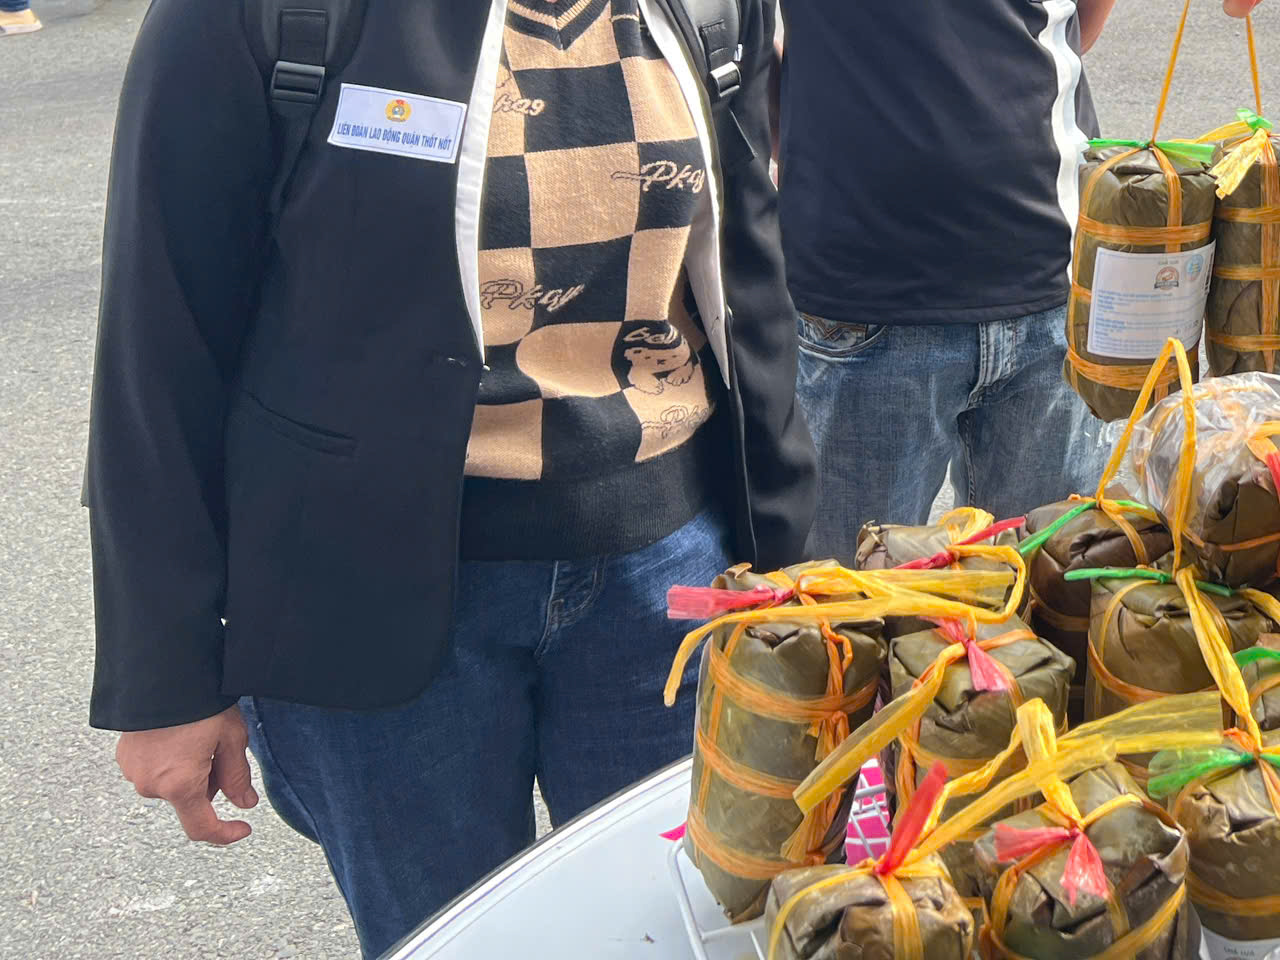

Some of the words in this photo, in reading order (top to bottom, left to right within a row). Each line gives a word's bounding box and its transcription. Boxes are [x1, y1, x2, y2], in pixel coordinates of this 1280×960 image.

[336, 121, 351, 136] LIÊN
[351, 123, 368, 138] ĐOÀN
[368, 126, 382, 140] LAO
[382, 125, 401, 144] ĐỘNG
[401, 130, 420, 148] QUẬN
[420, 132, 438, 149] THỐT
[438, 135, 451, 151] NỐT
